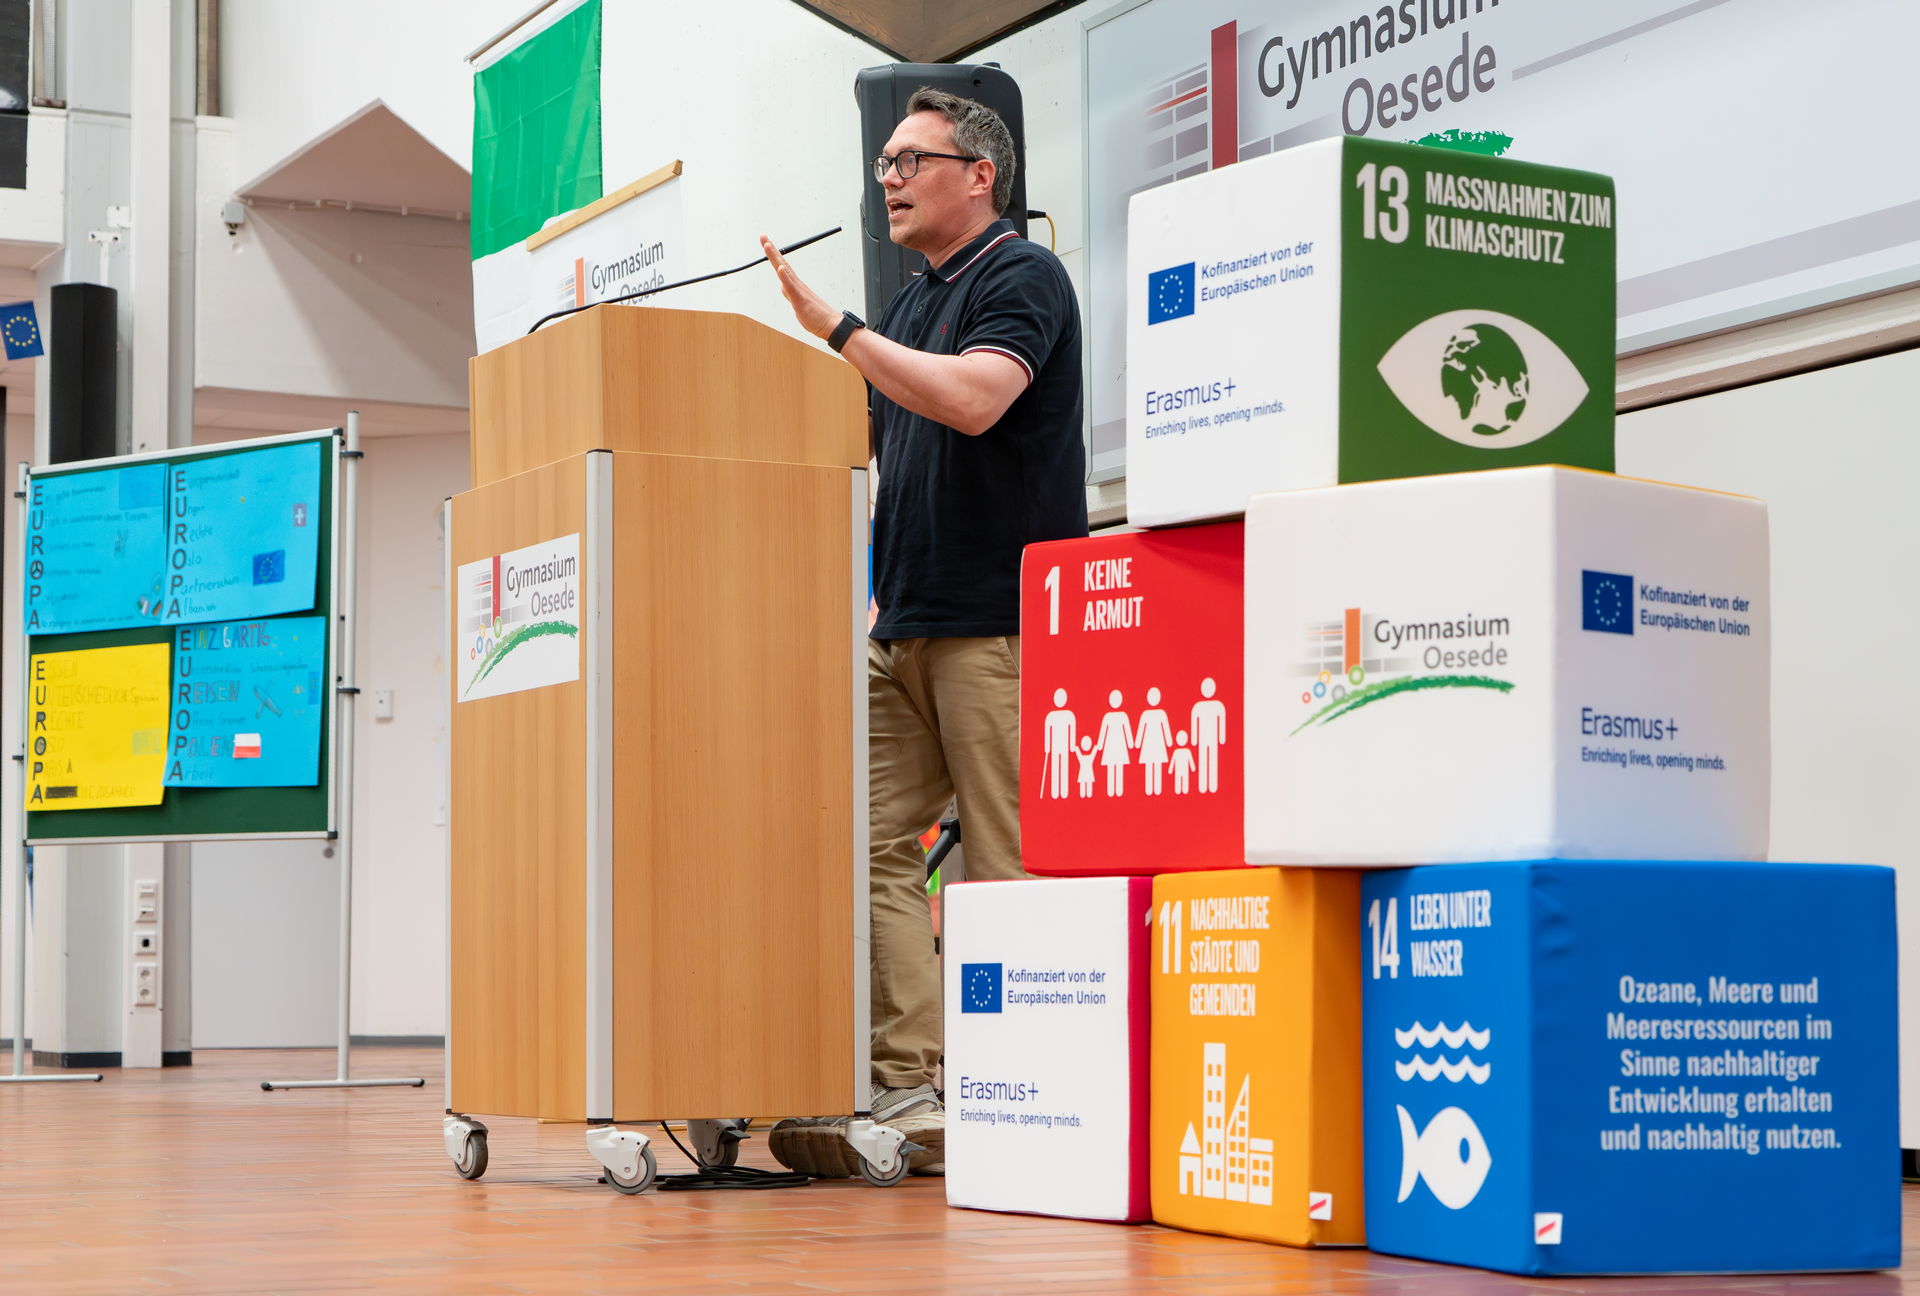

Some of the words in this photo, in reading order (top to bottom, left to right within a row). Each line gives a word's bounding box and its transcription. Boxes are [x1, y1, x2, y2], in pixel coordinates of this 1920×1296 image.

[1258, 0, 1499, 109] Gymnasiu
[1342, 31, 1496, 136] Oesede
[1357, 163, 1409, 243] 13
[1426, 171, 1567, 223] MASSNAHMEN
[1570, 192, 1611, 228] ZUM
[1426, 219, 1565, 265] KLIMASCHUTZ
[592, 241, 664, 295] Gymnasium
[1201, 252, 1268, 280] Kofinanziert
[1270, 247, 1291, 262] von
[1295, 240, 1314, 257] der
[1201, 269, 1276, 302] Europäischen
[1280, 262, 1314, 284] Union
[1146, 378, 1237, 415] Erasmus+
[1146, 420, 1187, 439] Enriching
[1188, 415, 1212, 429] lives,
[1213, 409, 1251, 426] opening
[1253, 400, 1286, 417] minds.
[507, 553, 576, 598] Gymnasium
[1085, 558, 1132, 591] KEINE
[531, 582, 575, 617] Oesede
[1045, 566, 1060, 635] 1
[1084, 597, 1143, 631] ARMUT
[1640, 584, 1706, 608] Kofinanziert
[1708, 597, 1729, 610] von
[1732, 596, 1750, 612] der
[1374, 613, 1510, 649] Gymnasium
[1640, 608, 1716, 634] Europäischen
[1719, 617, 1750, 636] Union
[1423, 641, 1508, 670] Oesede
[1581, 706, 1679, 741] Erasmus+
[1581, 746, 1628, 768] Enriching
[1629, 749, 1654, 767] lives,
[1655, 754, 1694, 773] opening
[1695, 755, 1726, 771] minds.
[1191, 896, 1270, 930] NACHHALTIGE
[1411, 893, 1449, 931] LEBEN
[1449, 890, 1491, 929] UNTER
[1160, 901, 1182, 974] 11
[1190, 936, 1233, 973] STÄDTE
[1235, 940, 1260, 973] UND
[1369, 898, 1400, 979] 14
[1411, 940, 1463, 976] WASSER
[1007, 968, 1066, 984] Kofinanziert
[1068, 972, 1089, 983] von
[1091, 969, 1106, 983] der
[1619, 975, 1702, 1006] Ozeane,
[1709, 976, 1773, 1003] Meere
[1780, 977, 1818, 1003] und
[1007, 989, 1074, 1007] Europäischen
[1076, 990, 1106, 1005] Union
[1190, 984, 1255, 1016] GEMEINDEN
[1607, 1013, 1799, 1039] Meeresressourcen
[1806, 1015, 1832, 1039] im
[1621, 1049, 1680, 1076] Sinne
[1687, 1050, 1819, 1081] nachhaltiger
[960, 1076, 1039, 1102] Erasmus+
[1609, 1086, 1738, 1118] Entwicklung
[1745, 1086, 1832, 1112] erhalten
[960, 1108, 996, 1126] Enriching
[997, 1110, 1017, 1124] lives,
[1019, 1114, 1052, 1129] opening
[1053, 1113, 1082, 1128] minds.
[1601, 1124, 1640, 1150] und
[1648, 1123, 1760, 1155] nachhaltig
[1766, 1125, 1842, 1149] nutzen.
